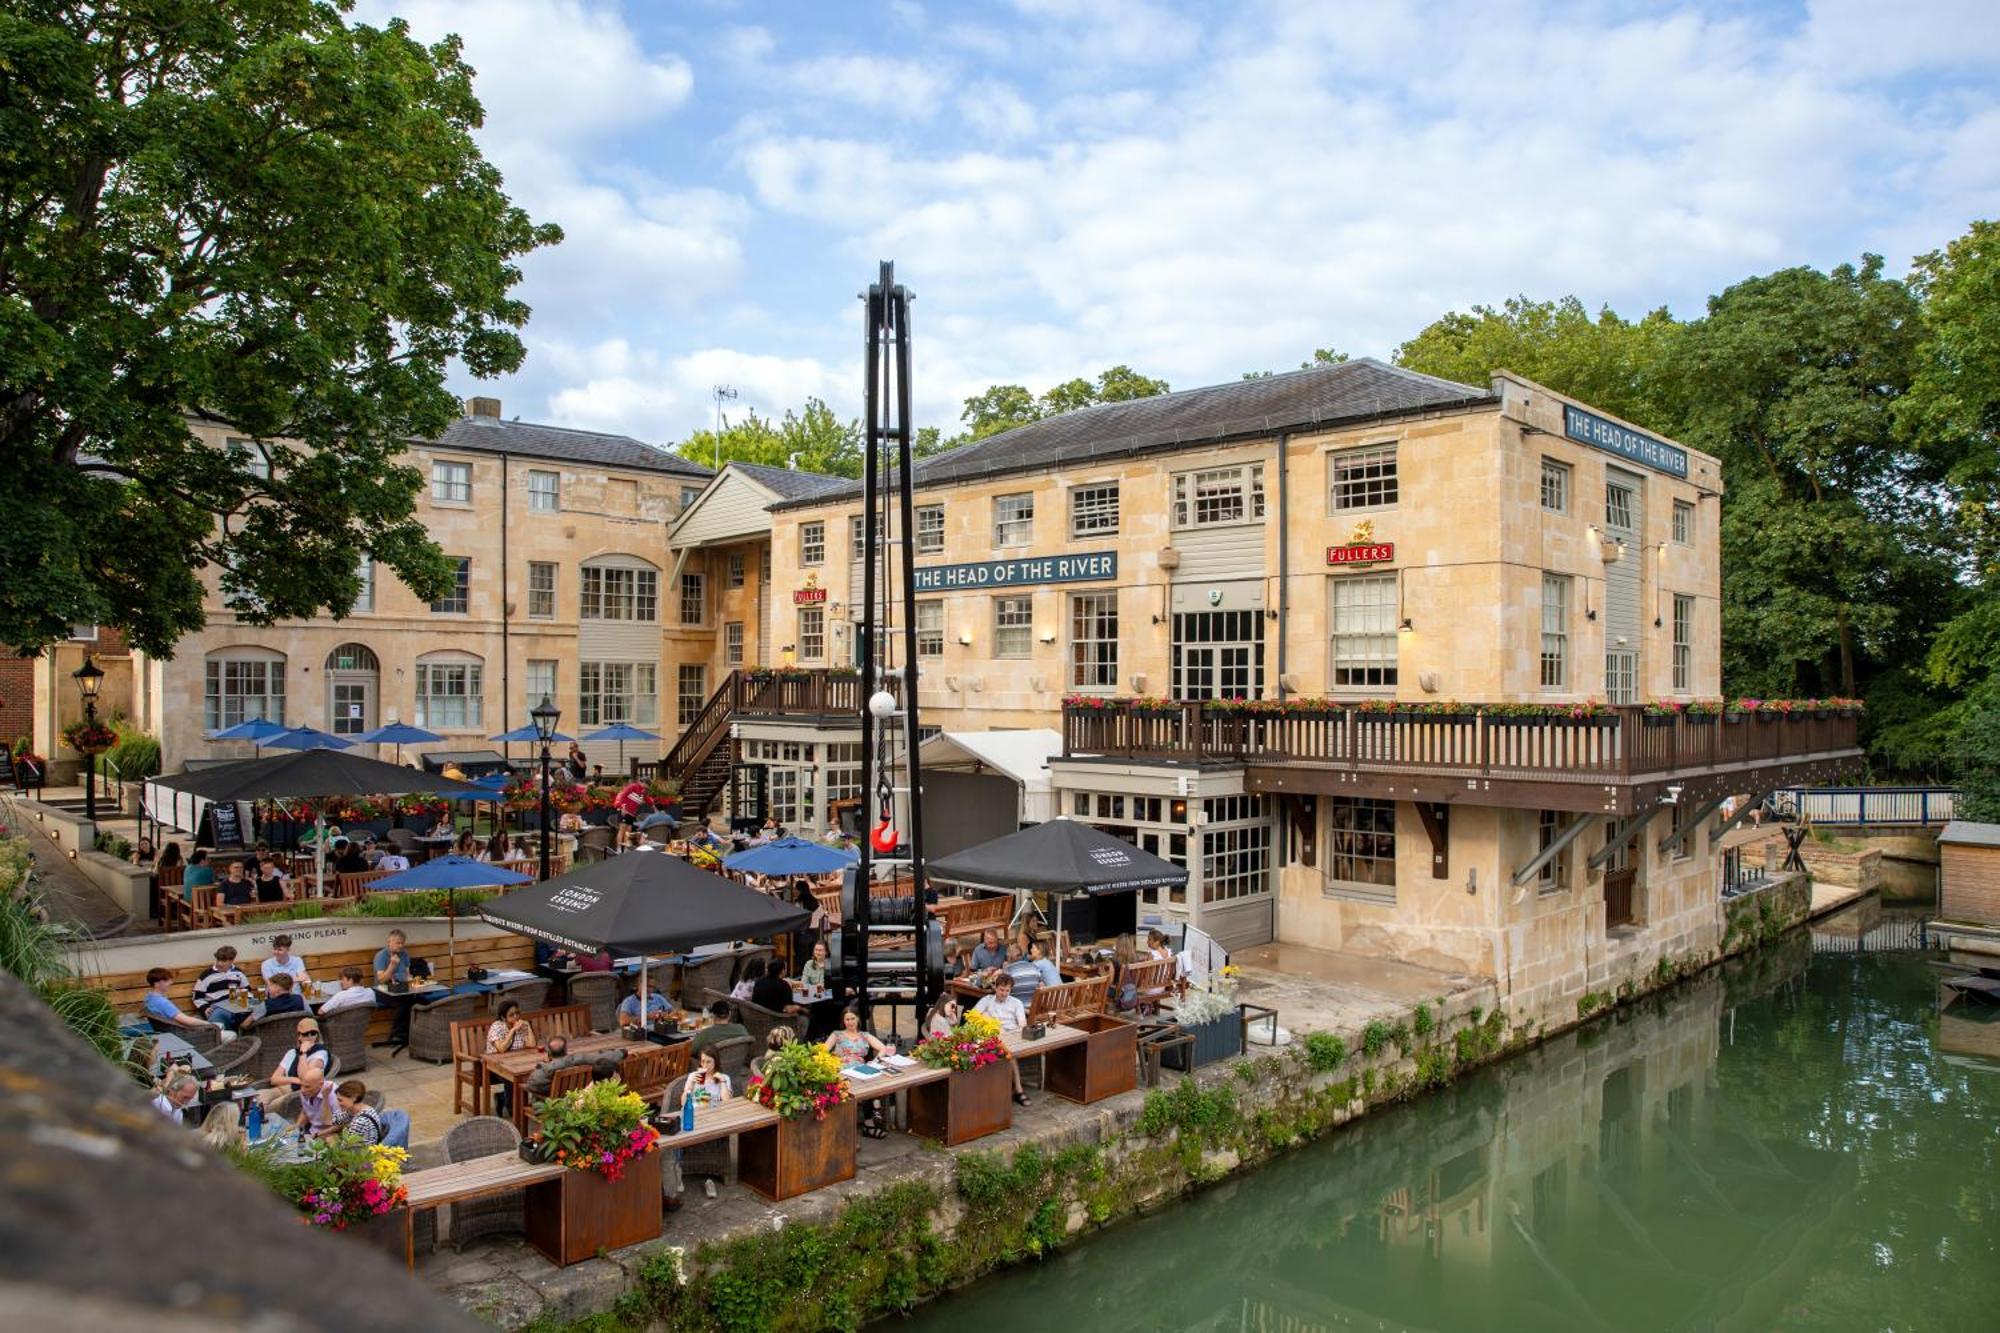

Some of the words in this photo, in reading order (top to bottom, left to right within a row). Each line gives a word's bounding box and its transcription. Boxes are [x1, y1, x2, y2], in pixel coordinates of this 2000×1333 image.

[1568, 412, 1590, 437] THE
[1593, 420, 1621, 448] HEAD
[1624, 434, 1637, 454] OF
[1640, 439, 1657, 462] THE
[1659, 447, 1685, 472] RIVER
[914, 570, 941, 588] THE
[946, 567, 988, 585] HEAD
[994, 564, 1016, 582] OF
[1021, 561, 1053, 580] THE
[1059, 556, 1112, 577] RIVER
[550, 895, 591, 910] ESSENCE
[559, 888, 600, 904] LONDON
[251, 937, 266, 945] NO
[268, 930, 312, 944] SKING
[314, 927, 348, 938] PLEASE
[523, 924, 538, 935] FROM
[538, 929, 563, 943] DISTILLED
